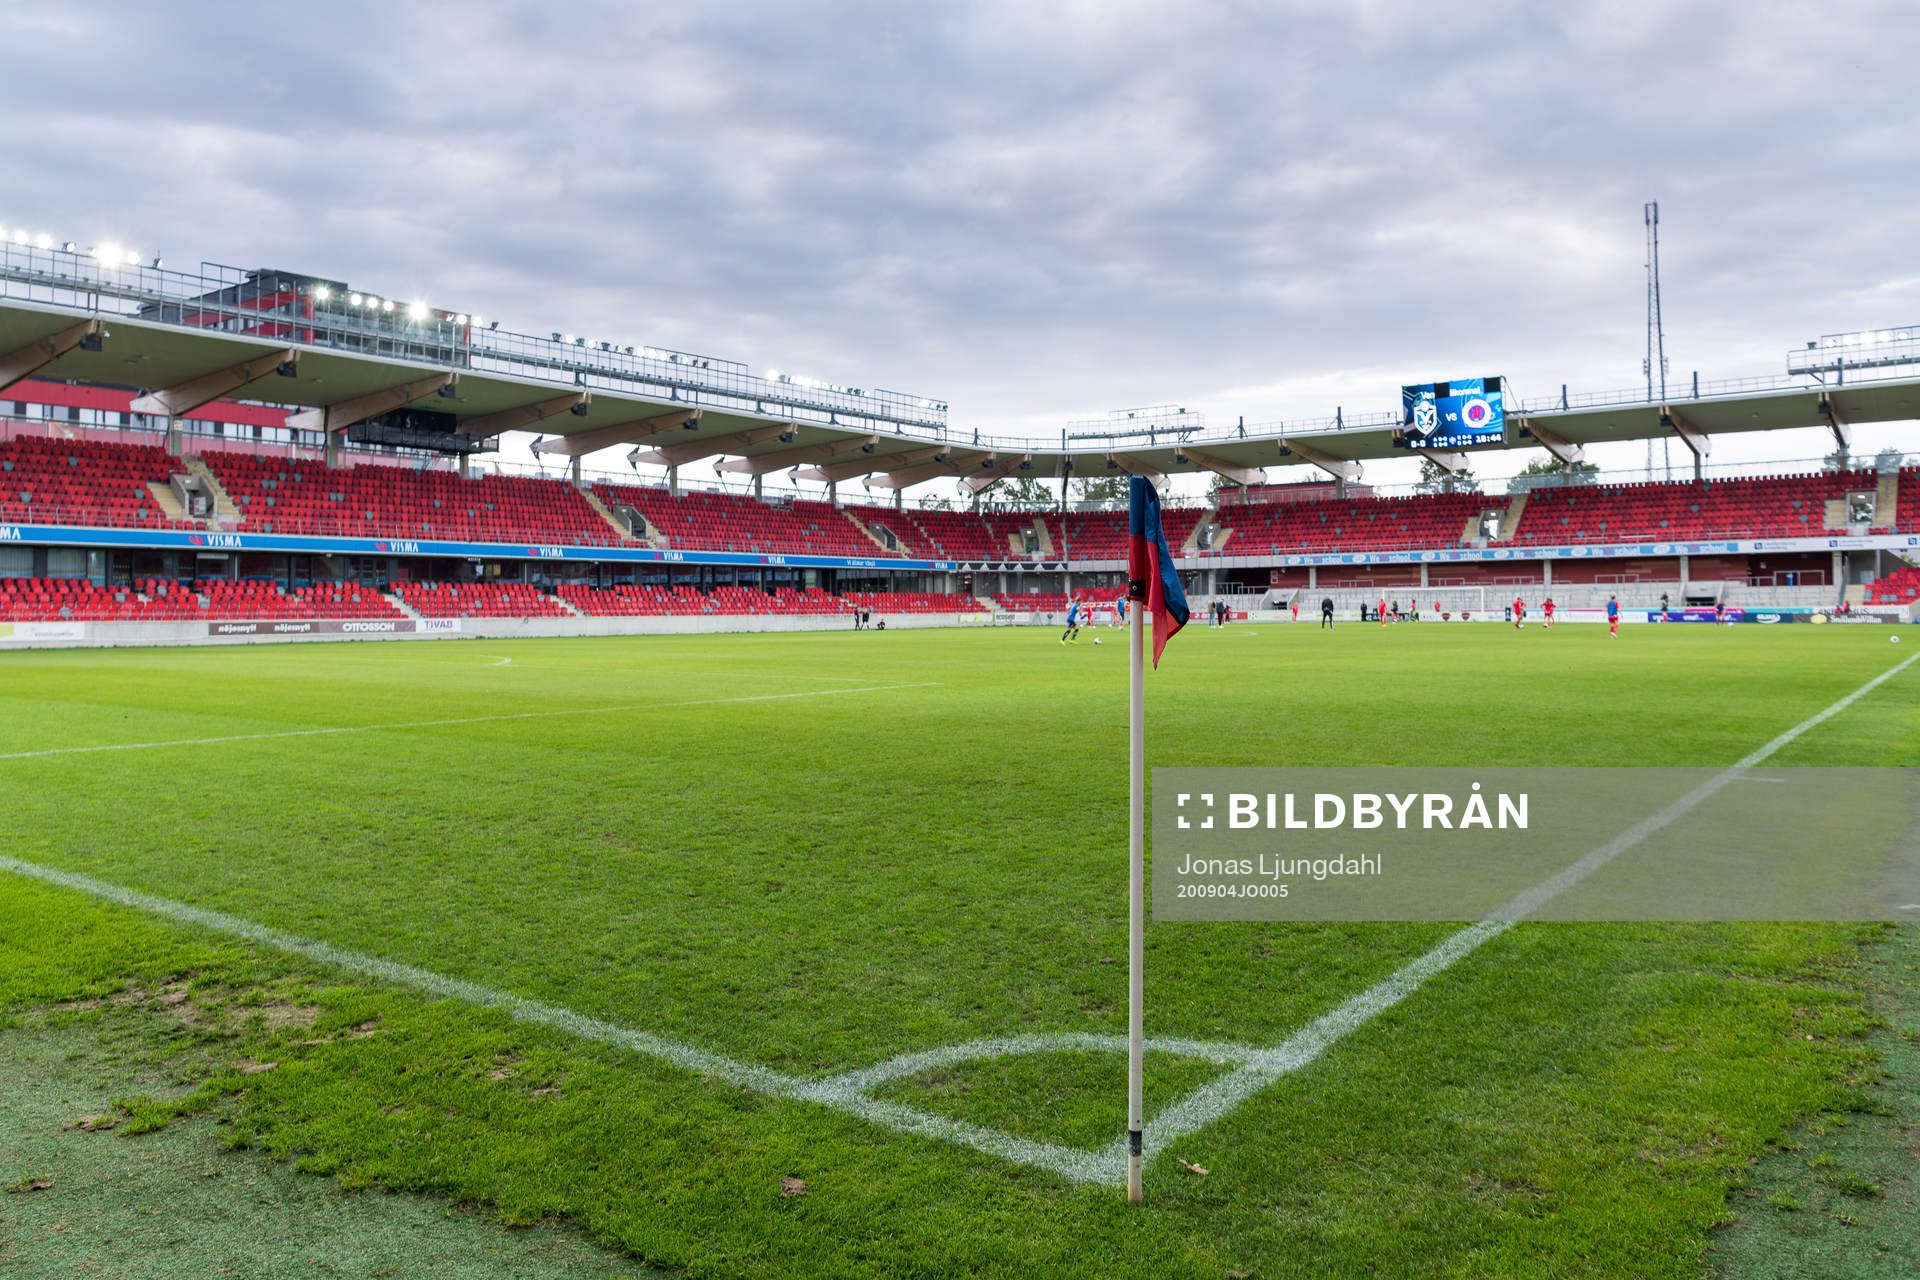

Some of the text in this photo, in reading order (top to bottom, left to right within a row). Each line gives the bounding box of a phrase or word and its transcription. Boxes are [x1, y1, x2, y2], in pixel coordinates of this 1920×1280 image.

[207, 535, 242, 547] VISMA
[390, 541, 419, 553] VISMA
[539, 547, 564, 557] VISMA
[663, 552, 684, 561] VISMA
[1460, 550, 1482, 560] school
[342, 622, 395, 632] OTTOSSON
